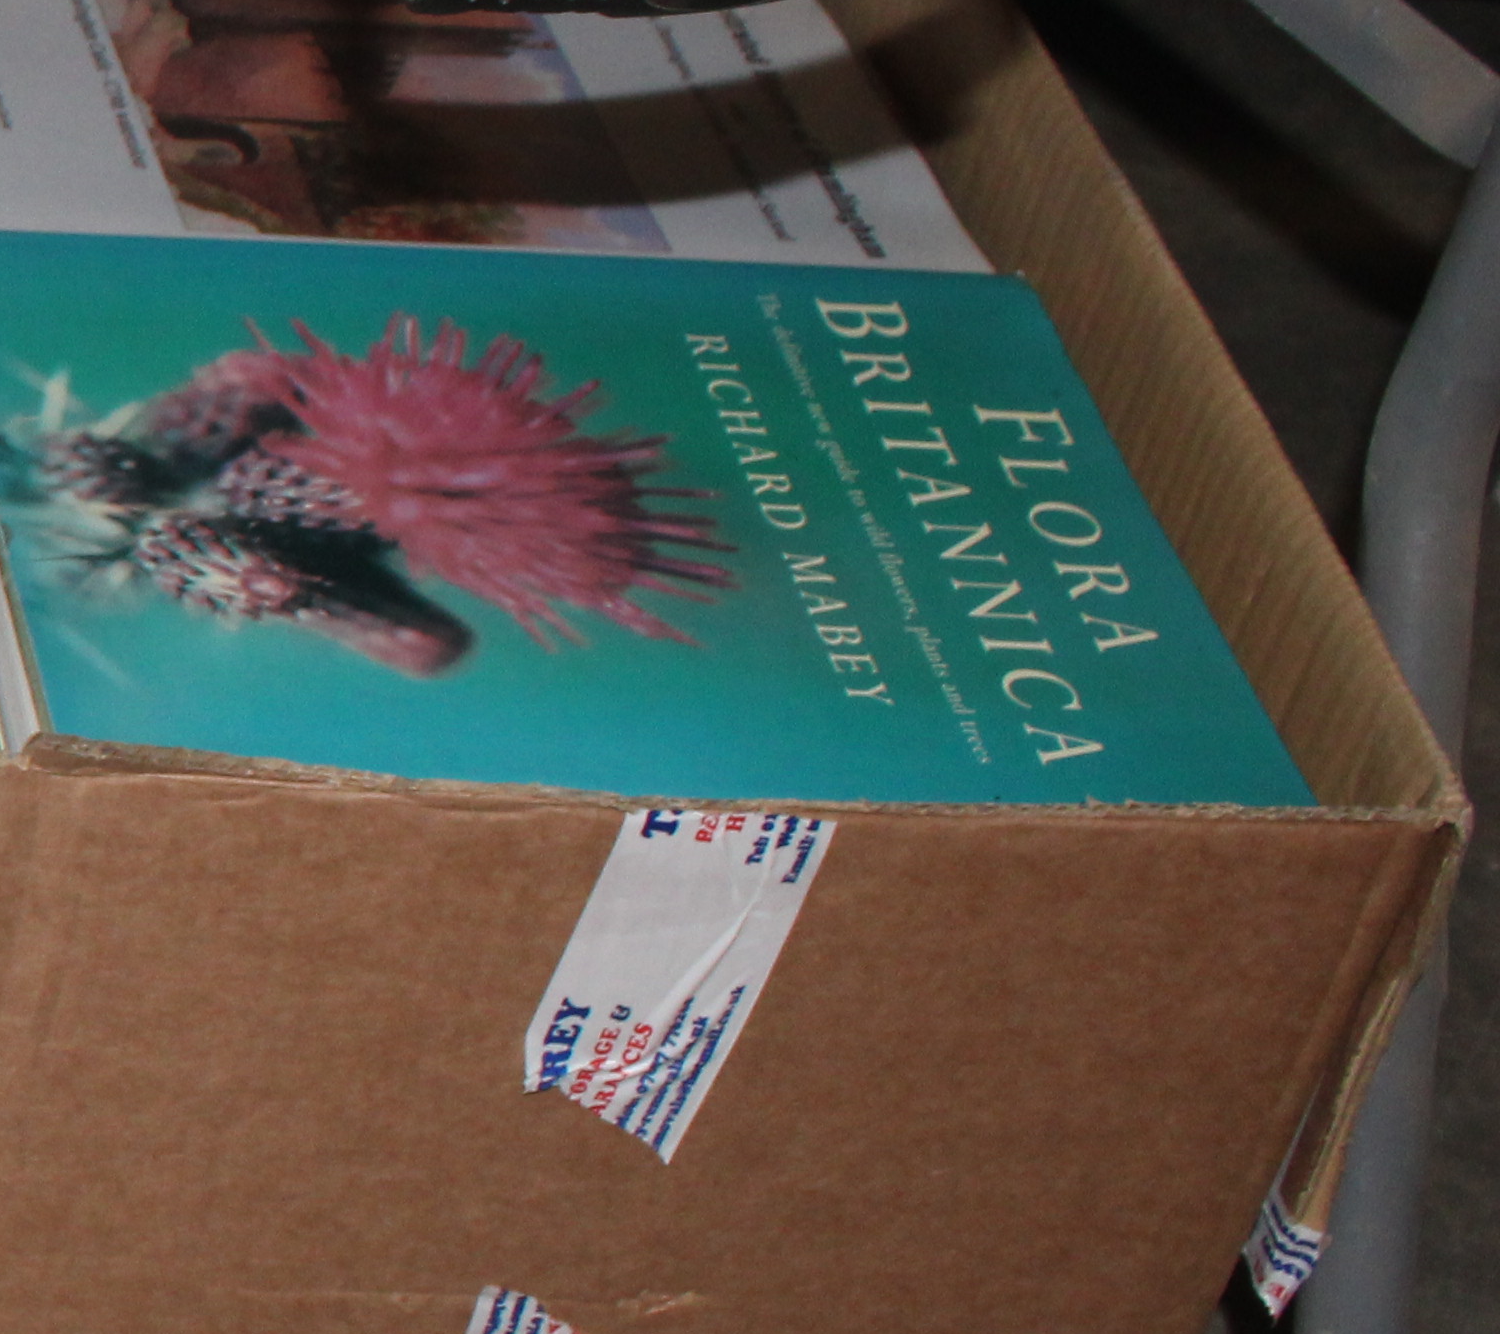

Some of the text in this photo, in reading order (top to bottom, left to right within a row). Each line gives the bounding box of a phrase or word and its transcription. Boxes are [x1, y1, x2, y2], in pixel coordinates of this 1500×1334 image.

[685, 332, 808, 532] RICHARD
[783, 551, 894, 706] MABEY
[815, 297, 1106, 766] BRITANNICA
[972, 404, 1159, 653] FLORA
[911, 623, 952, 680] plants
[941, 681, 975, 722] and
[959, 720, 992, 766] trees
[568, 1027, 621, 1105] ORAGE
